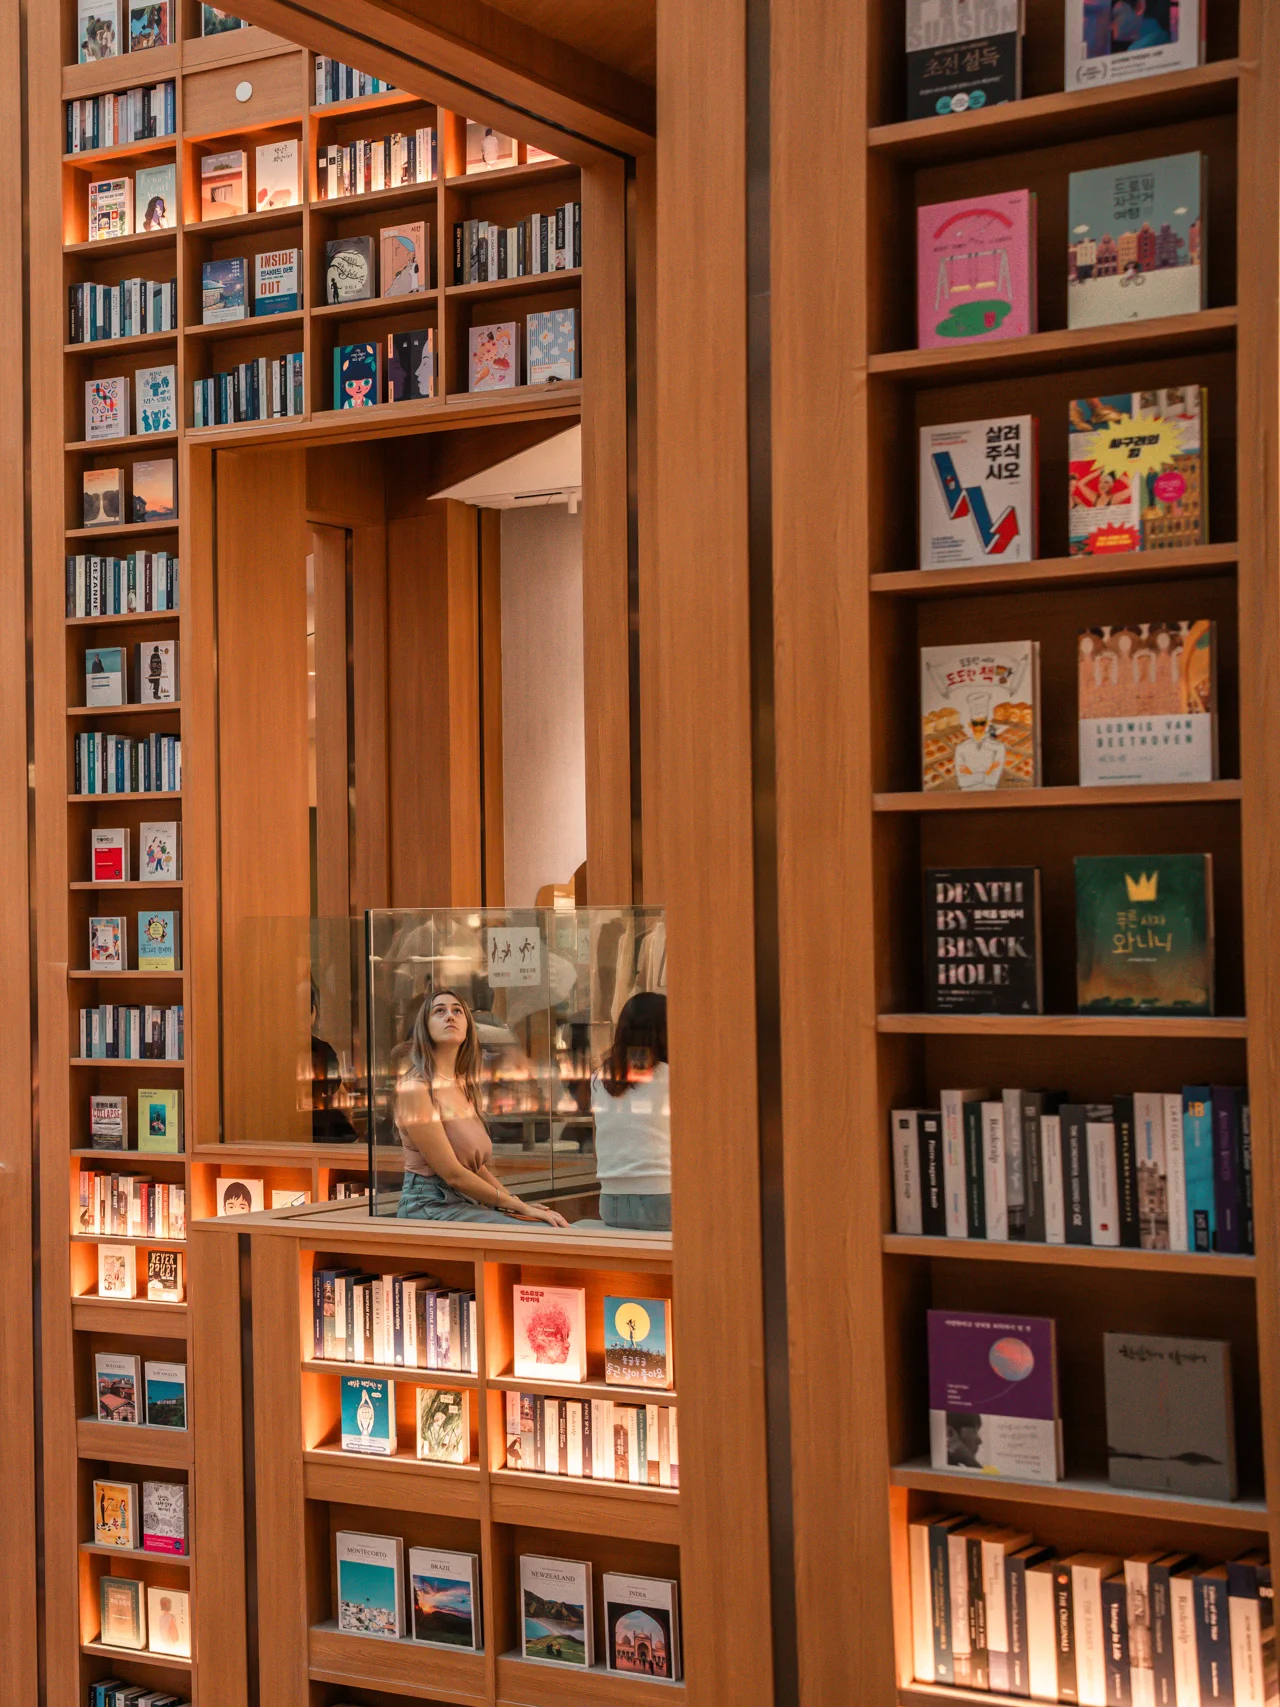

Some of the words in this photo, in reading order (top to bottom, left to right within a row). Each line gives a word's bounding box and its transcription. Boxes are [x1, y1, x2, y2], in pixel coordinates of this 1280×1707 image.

[260, 251, 294, 268] INSIDE
[260, 268, 282, 277] 인사이드
[260, 280, 281, 295] OUT
[91, 412, 118, 424] LIFE
[985, 423, 1020, 443] 살려
[985, 443, 1020, 462] 주식
[985, 463, 1020, 481] 시오
[1096, 721, 1153, 734] LUDWIG
[1165, 719, 1193, 730] VAN
[1096, 734, 1193, 748] BEETHOVEN
[935, 881, 1023, 904] DEATH
[936, 909, 968, 931] BY
[936, 936, 1028, 957] BLACK
[1112, 927, 1173, 954] 와니니
[936, 964, 1010, 985] HOLE
[92, 1107, 121, 1119] COLLAPSE
[150, 1253, 174, 1266] NEVER
[149, 1264, 177, 1277] DOUBT
[346, 1547, 387, 1559] MONTECORTO
[431, 1563, 451, 1572] BRAZIL
[530, 1570, 576, 1583] NEWZEALAND
[628, 1590, 647, 1599] INDIA
[1060, 1608, 1069, 1651] ORIGINALS
